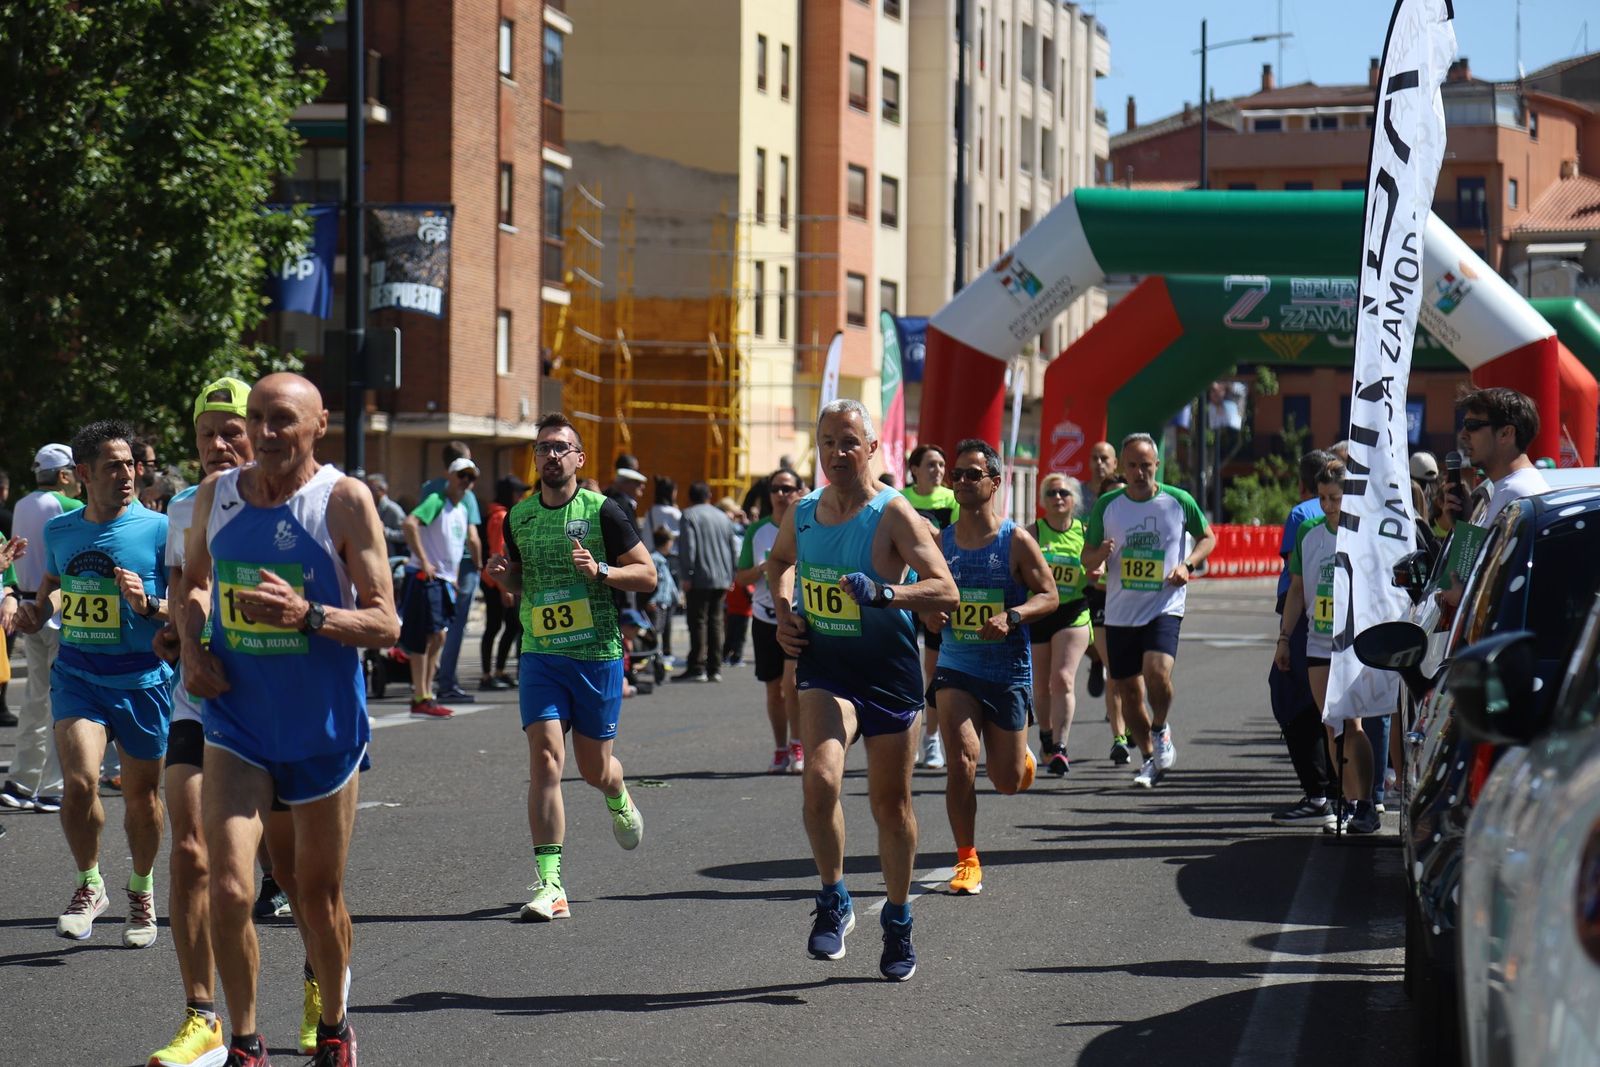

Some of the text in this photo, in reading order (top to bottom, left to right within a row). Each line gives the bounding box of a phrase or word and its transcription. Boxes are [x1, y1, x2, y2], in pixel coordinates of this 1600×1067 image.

[1280, 304, 1357, 331] ZAM
[1050, 564, 1074, 583] 05
[1124, 561, 1156, 578] 182
[805, 582, 843, 614] 116
[62, 594, 109, 623] 243
[542, 604, 574, 630] 83
[956, 604, 993, 626] 120
[71, 630, 117, 639] CAJA RURAL
[815, 619, 858, 631] CAJA RURAL
[242, 637, 301, 648] CAJA RURAL
[552, 632, 593, 645] CAJA RURAL
